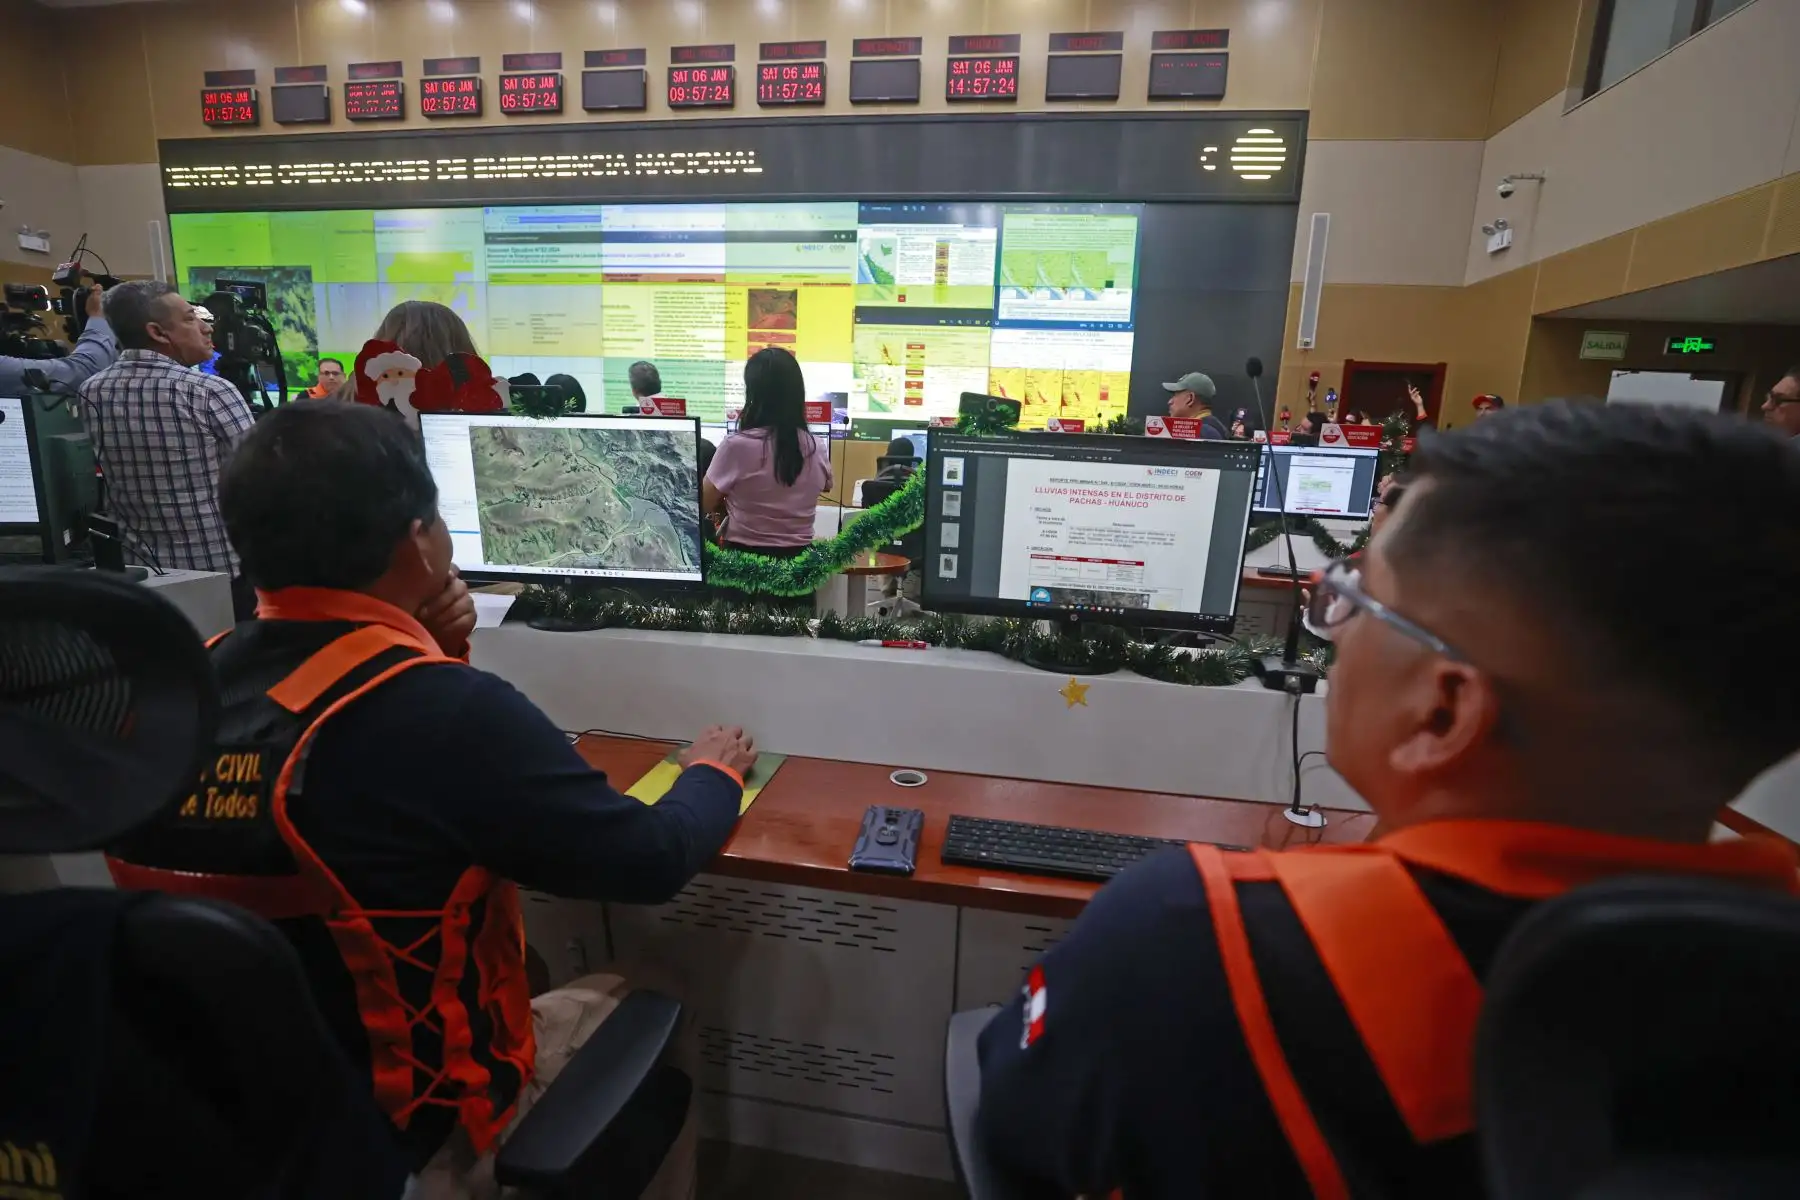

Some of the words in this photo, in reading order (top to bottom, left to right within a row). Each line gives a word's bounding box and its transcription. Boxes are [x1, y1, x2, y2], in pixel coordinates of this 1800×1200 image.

[763, 67, 779, 80] SAT
[783, 67, 798, 80] 06
[802, 65, 819, 79] JAN
[952, 61, 970, 74] SAT
[974, 61, 991, 74] 06
[995, 60, 1013, 73] JAN
[504, 78, 518, 90] SAT
[522, 77, 536, 89] 06
[539, 76, 555, 89] JAN
[673, 71, 688, 83] SAT
[692, 70, 707, 82] 06
[711, 68, 727, 82] JAN
[425, 81, 439, 94] SAT
[442, 81, 456, 93] 06
[459, 80, 473, 92] JAN
[669, 85, 730, 101] 09:57:24
[760, 82, 821, 99] 11:57:24
[949, 77, 1015, 94] 14:57:24
[205, 93, 217, 104] SAT
[220, 92, 233, 103] 06
[235, 90, 249, 102] JAN
[423, 96, 477, 112] 02:57:24
[502, 92, 557, 108] 05:57:24
[204, 106, 253, 122] 21:57:24
[244, 165, 274, 185] DE
[278, 159, 430, 184] OPERACIONES
[436, 158, 468, 180] DE
[473, 153, 631, 178] EMERGENCIA
[635, 151, 763, 175] NACIONAL
[1154, 468, 1178, 476] INDECI
[1035, 486, 1068, 495] LLUVIAS
[1069, 488, 1109, 498] INTENSAS
[1124, 491, 1134, 499] EL
[1135, 492, 1172, 502] DISTRITO
[1069, 497, 1103, 506] PACHAS
[216, 753, 262, 783] CIVIL
[204, 786, 258, 818] Todos
